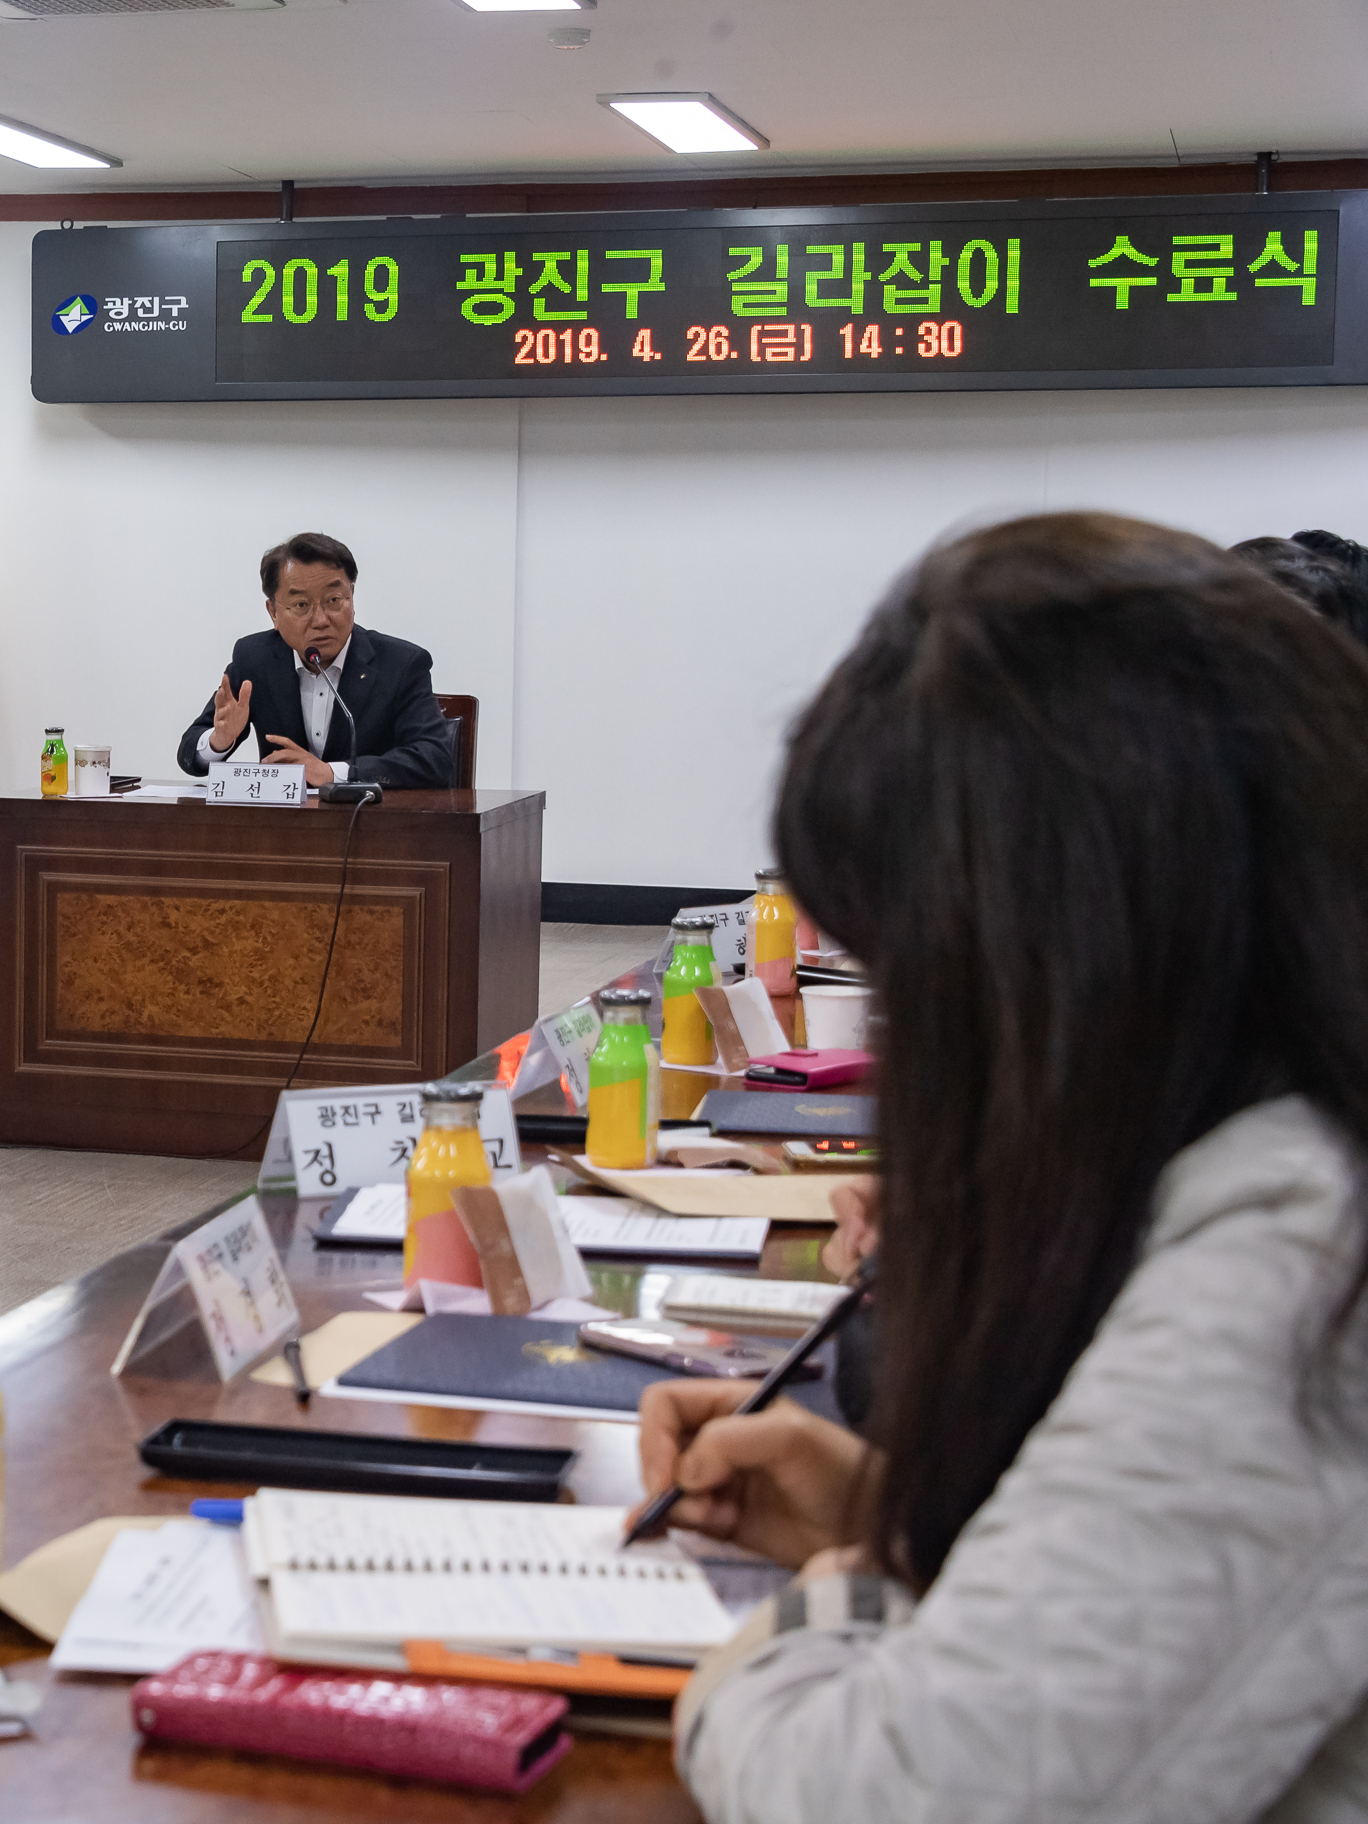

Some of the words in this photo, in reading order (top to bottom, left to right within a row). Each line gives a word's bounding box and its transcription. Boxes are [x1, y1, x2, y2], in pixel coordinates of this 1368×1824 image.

[241, 256, 399, 324] 2019
[455, 249, 666, 325] 광진구
[726, 238, 1021, 317] 길라잡이
[1087, 230, 1319, 309] 수료식
[103, 296, 189, 319] 광진구
[104, 320, 187, 332] GWANGJIN-GU
[514, 328, 608, 364] 2019.
[632, 328, 663, 361] 4.
[233, 767, 280, 778] 광진구청장
[317, 1103, 382, 1128] 광진구
